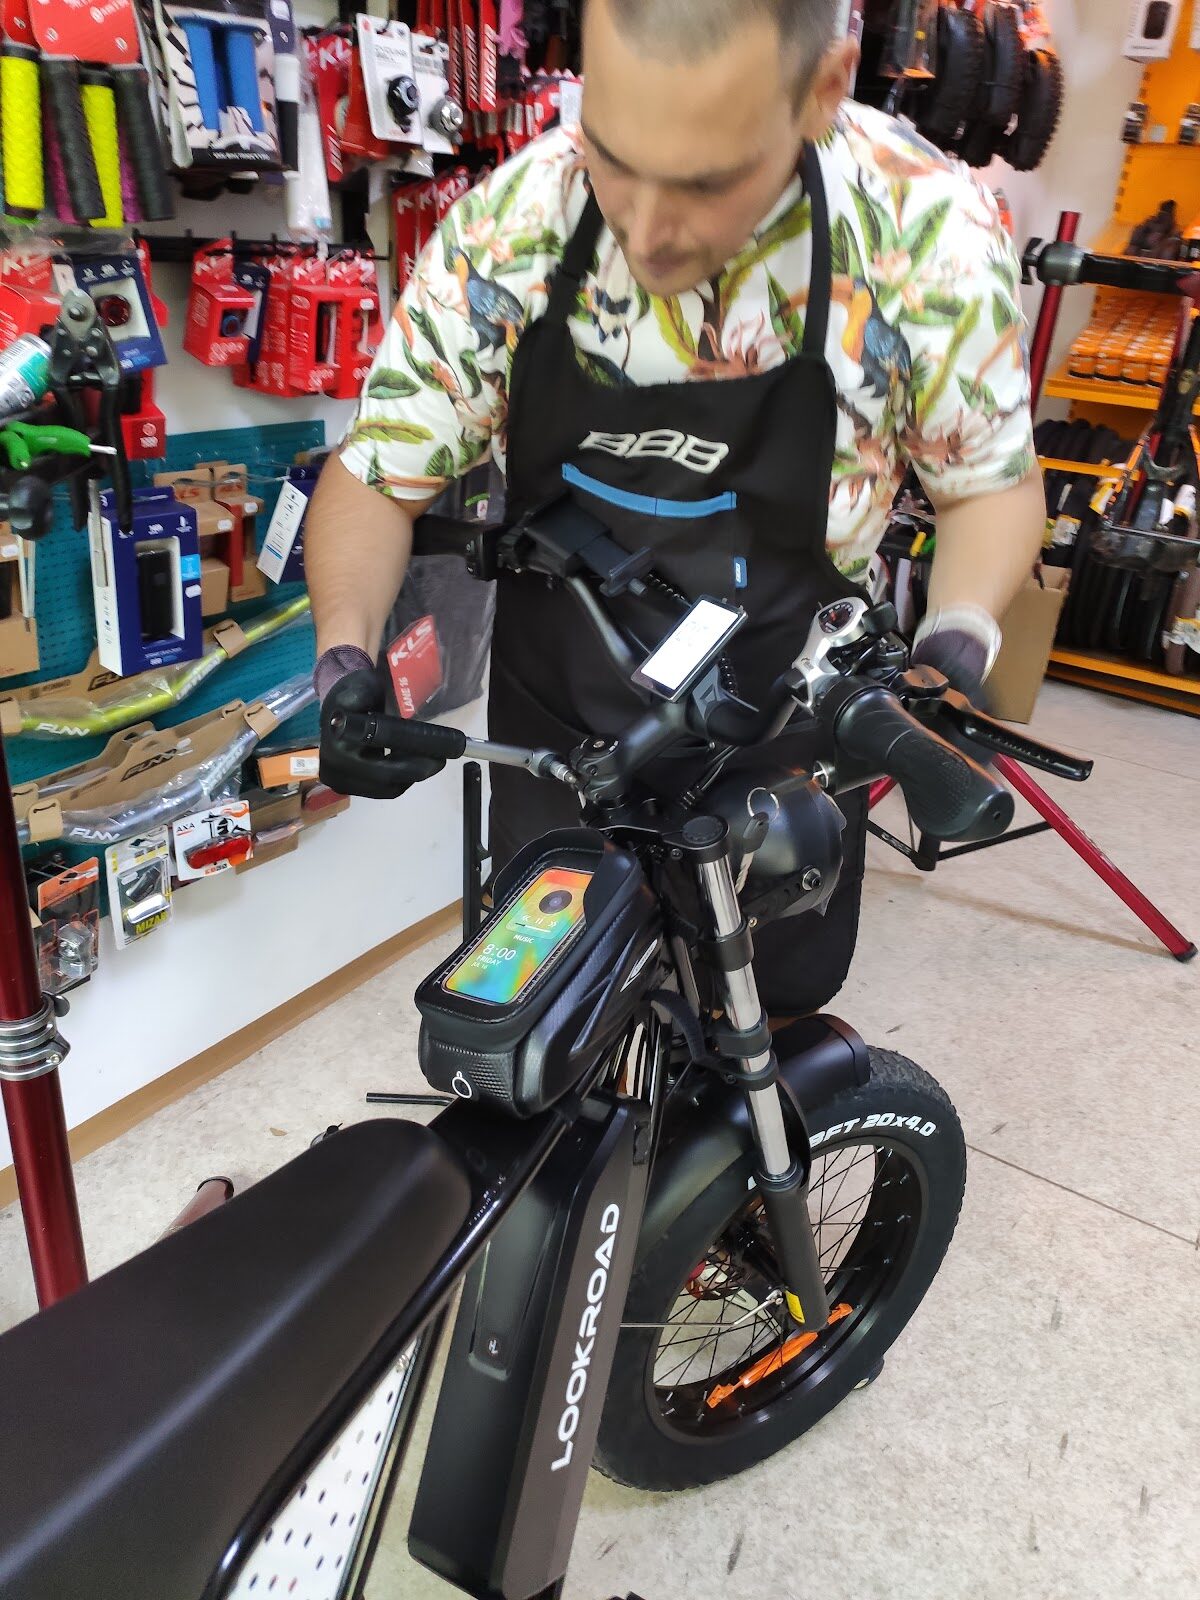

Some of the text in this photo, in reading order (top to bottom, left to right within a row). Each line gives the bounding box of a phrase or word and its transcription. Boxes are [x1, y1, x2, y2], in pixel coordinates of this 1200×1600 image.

[578, 428, 730, 475] BBB
[391, 619, 432, 668] KLS
[512, 934, 534, 944] MUSIC
[476, 954, 502, 966] FRIDAY
[482, 943, 517, 961] 8:00
[861, 1112, 937, 1137] 20x4.0
[551, 1203, 620, 1472] LOOKROAD
